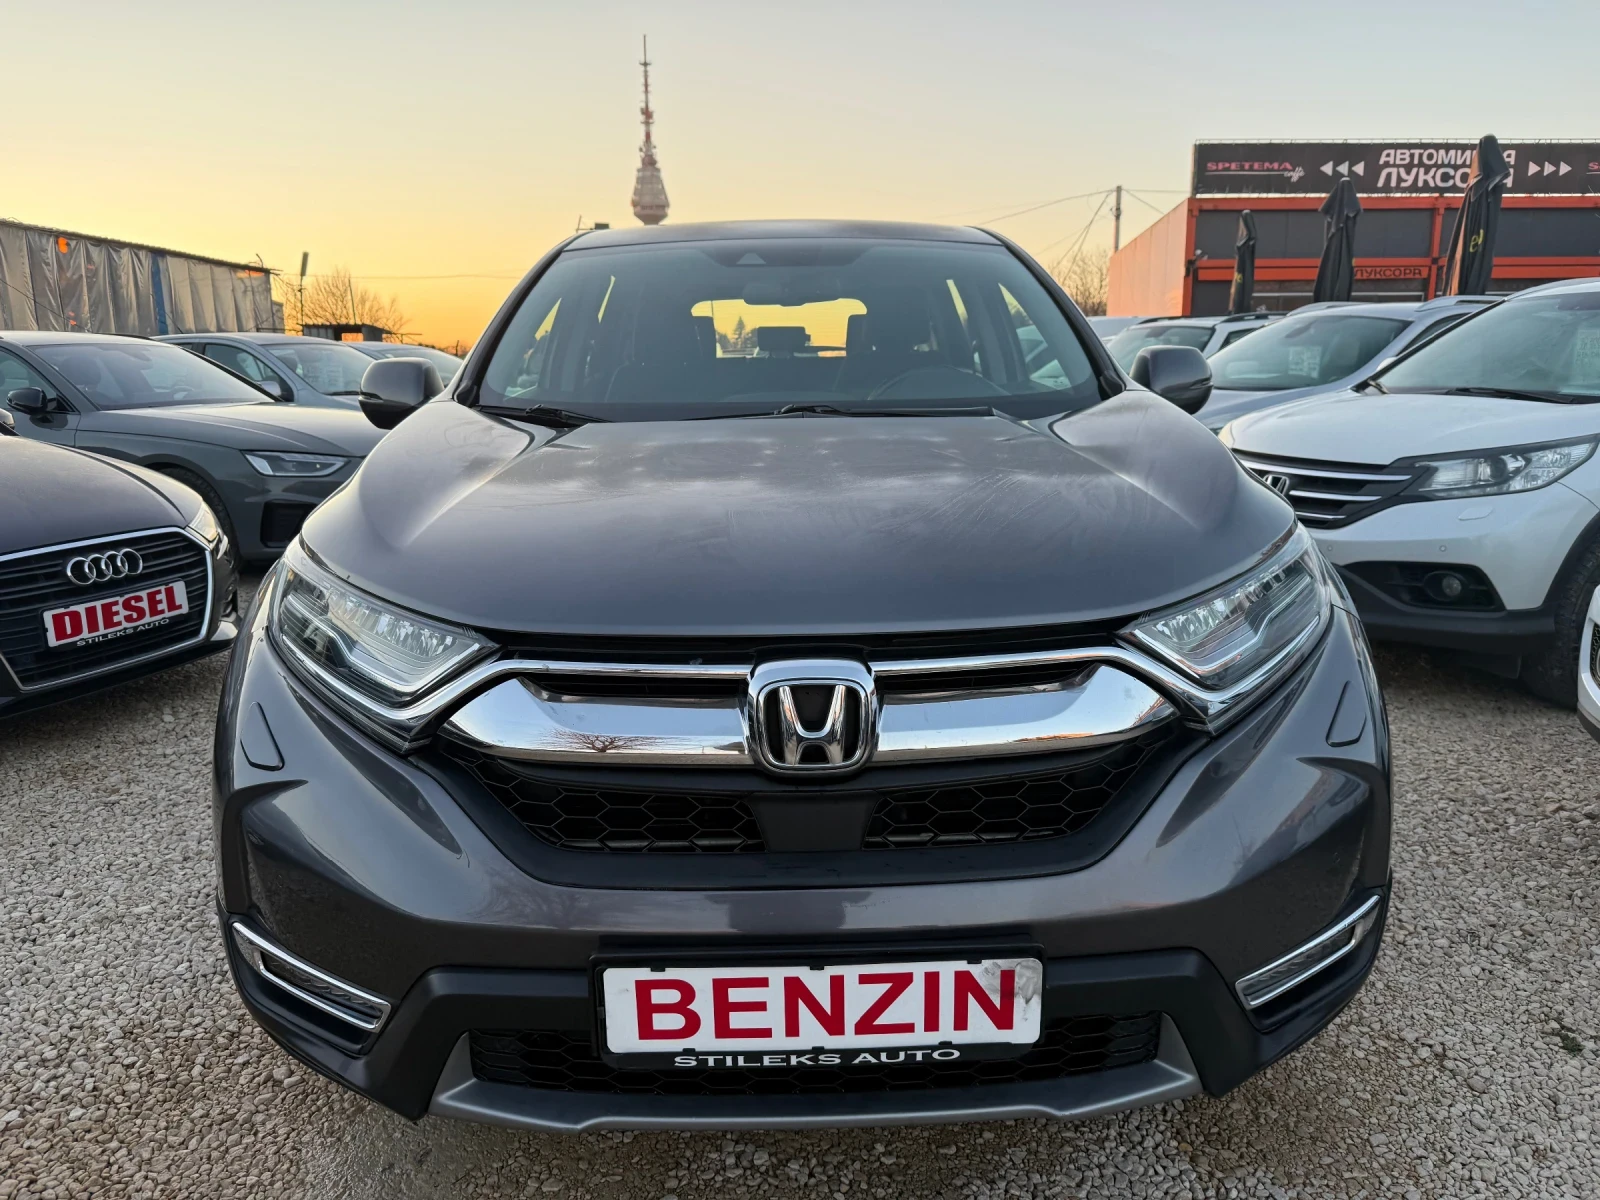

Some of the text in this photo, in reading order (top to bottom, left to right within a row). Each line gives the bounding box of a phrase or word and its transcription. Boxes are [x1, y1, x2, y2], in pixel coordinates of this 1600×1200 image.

[1206, 161, 1293, 171] SPETEMA
[1378, 148, 1516, 165] АВТОМИА
[1354, 268, 1422, 278] ЛУКСОРА
[51, 585, 183, 642] DIESEL
[76, 618, 170, 647] STILEKS AUTO
[634, 969, 1016, 1041] BENZIN
[674, 1048, 961, 1067] STILEKS AUTO
